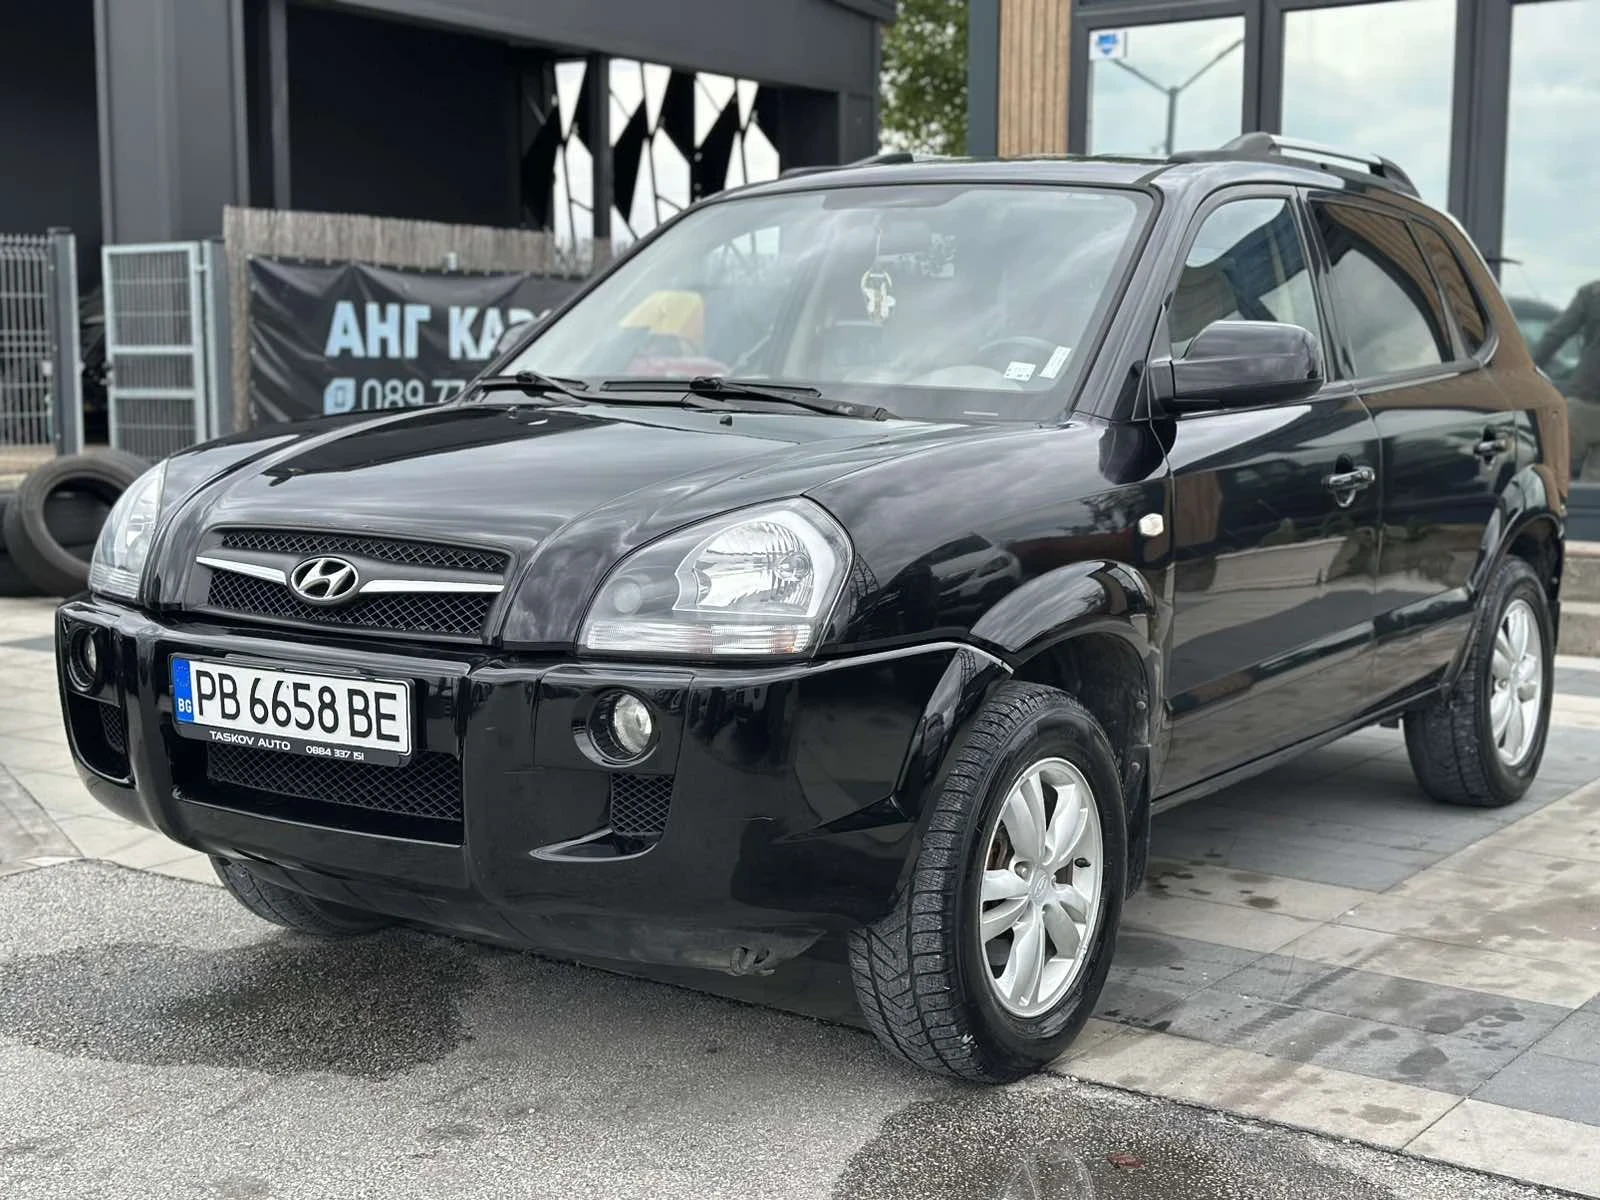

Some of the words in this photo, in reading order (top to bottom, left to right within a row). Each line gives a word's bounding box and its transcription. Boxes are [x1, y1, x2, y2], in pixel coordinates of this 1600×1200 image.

[325, 301, 431, 359] АНГ
[362, 379, 425, 409] 089
[178, 697, 192, 714] BG
[195, 669, 240, 720] PB
[249, 677, 339, 734] 6658
[347, 688, 400, 742] BE
[209, 730, 254, 745] TASKOV
[258, 738, 291, 751] AUTO
[305, 745, 332, 757] 0884
[334, 749, 351, 759] 337
